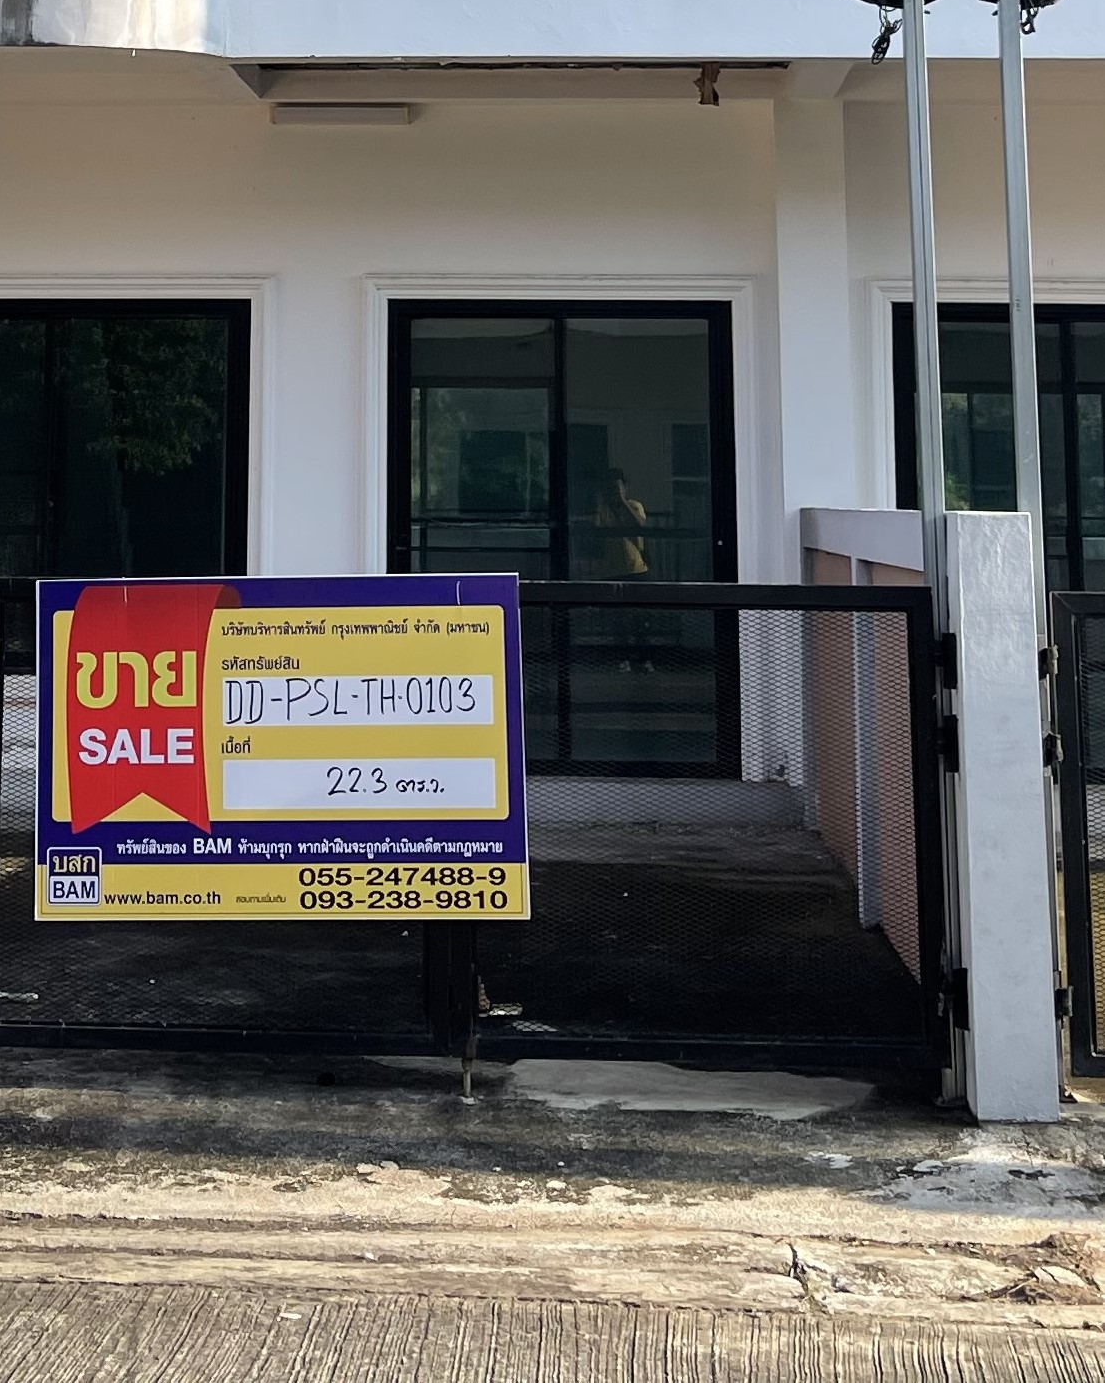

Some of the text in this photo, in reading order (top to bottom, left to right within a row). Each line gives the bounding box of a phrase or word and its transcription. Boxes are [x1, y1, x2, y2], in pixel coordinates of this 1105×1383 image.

[221, 619, 490, 640] บริษัทบริหารสินทรัพย์ กรุงเทพพาณิชย์ จำกัด (มหาชน)
[221, 655, 300, 671] รหัสทรัพย์สิน
[76, 651, 197, 709] ขาย
[78, 728, 195, 765] SALE
[221, 736, 251, 754] เนื้อที่
[326, 766, 388, 796] 22.3
[116, 836, 504, 860] ทรัพย์สินของ BAM ห้ามบุกรุก หากฝ่าฝืนจะถูกดำเนินคดีตามกฎหมาย
[52, 854, 96, 873] บสก
[298, 867, 507, 887] 055-247488-9
[52, 880, 96, 899] BAM
[104, 890, 221, 905] www.bam.co.th
[299, 890, 509, 910] 093-238-9810
